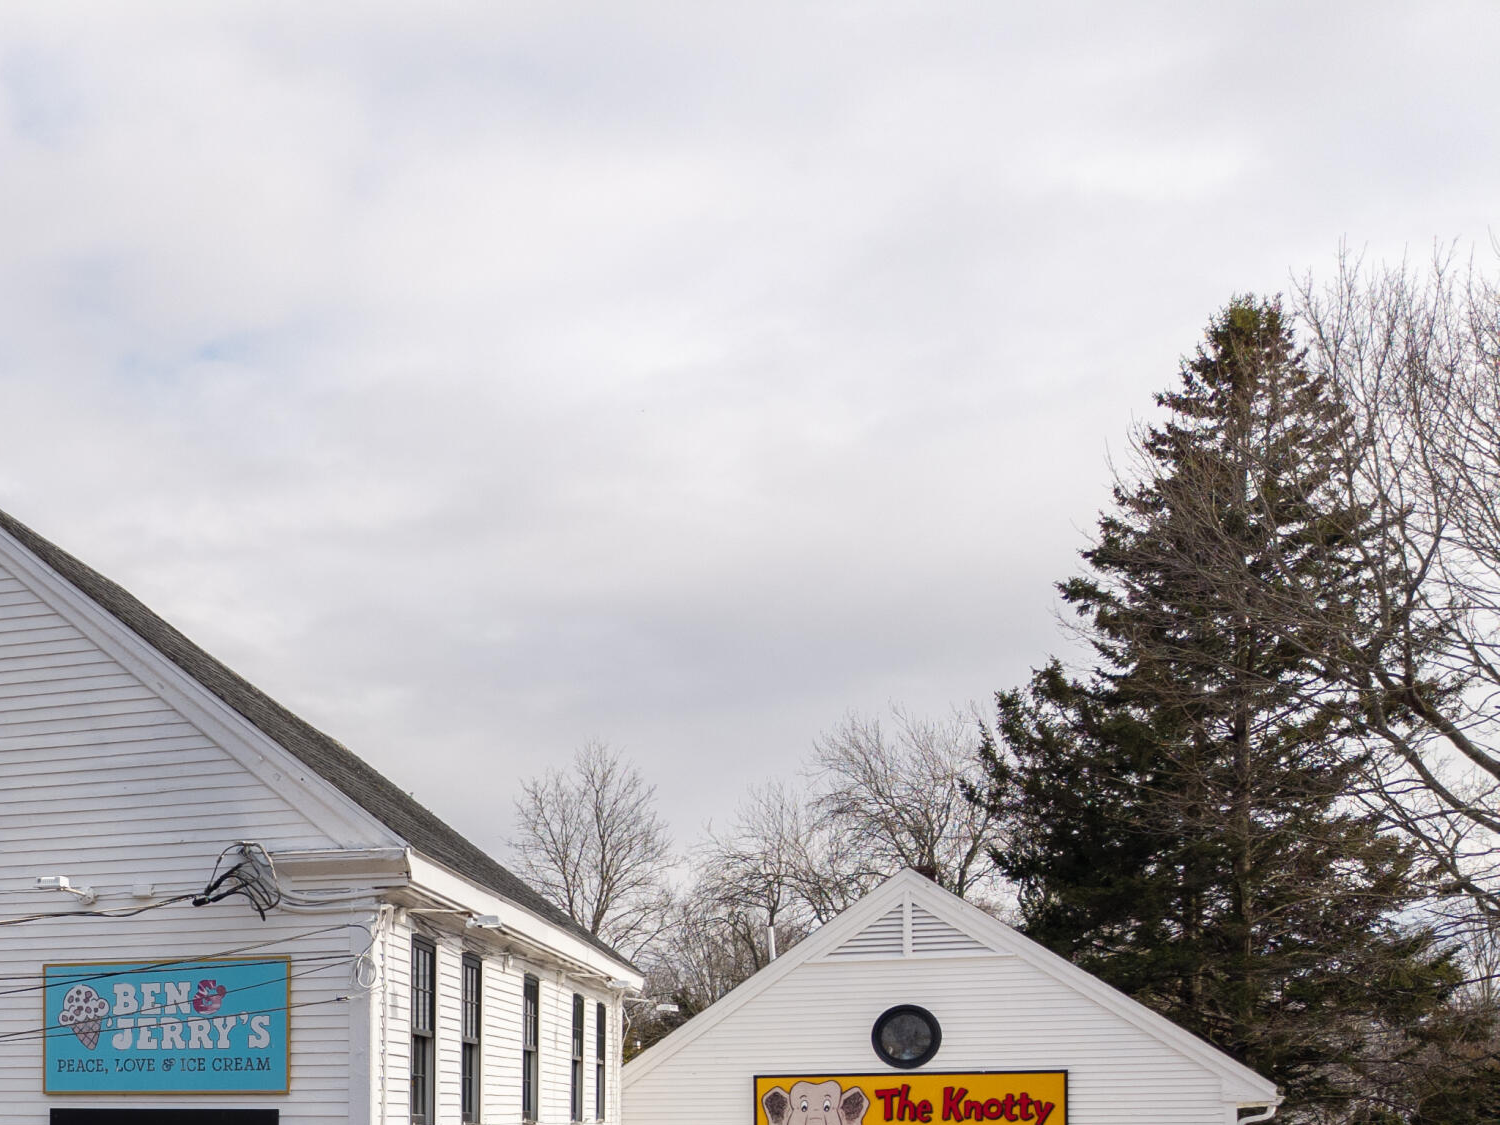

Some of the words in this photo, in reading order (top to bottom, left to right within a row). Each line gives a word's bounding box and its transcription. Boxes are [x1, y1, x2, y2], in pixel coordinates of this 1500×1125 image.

[112, 981, 191, 1015] BEN
[111, 1011, 271, 1050] JERRY'S
[57, 1058, 108, 1074] PEACE,
[114, 1058, 155, 1073] LOVE
[162, 1059, 176, 1073] &
[180, 1058, 206, 1072] ICE
[211, 1057, 271, 1072] CREAM
[874, 1084, 933, 1122] The
